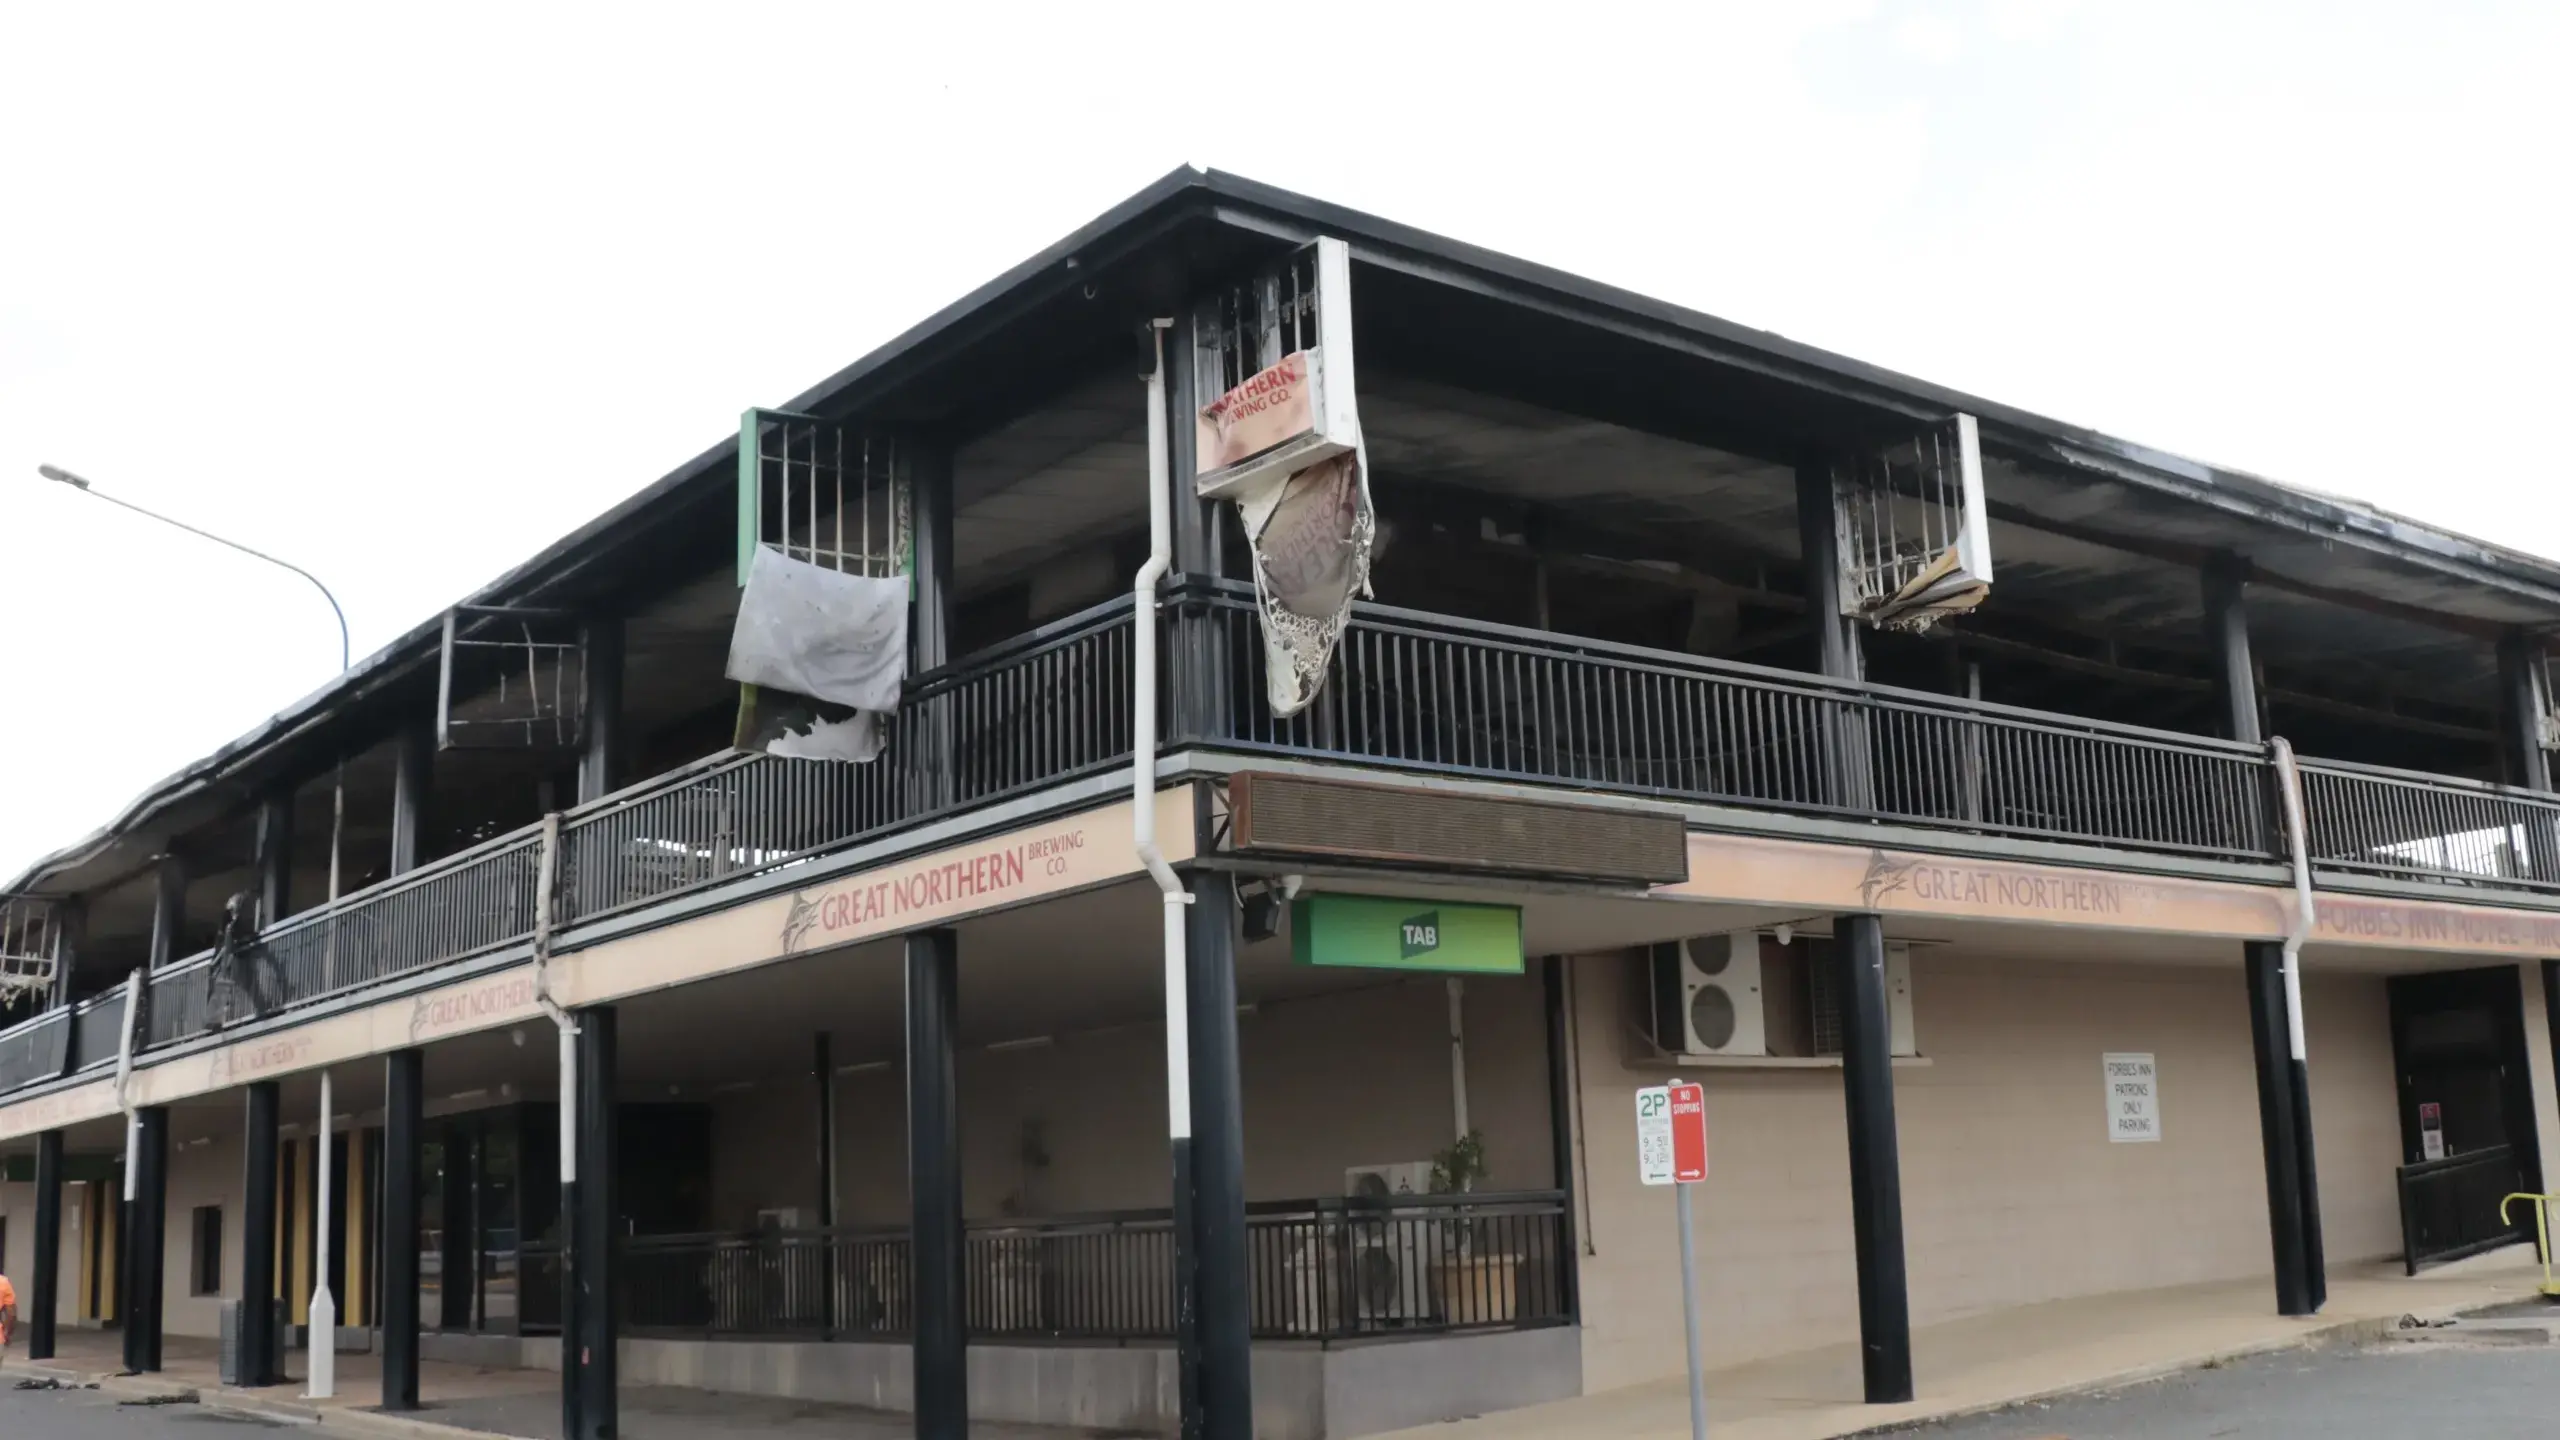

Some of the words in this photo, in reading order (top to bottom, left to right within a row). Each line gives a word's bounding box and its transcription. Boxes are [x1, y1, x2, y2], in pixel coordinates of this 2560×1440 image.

[1226, 397, 1267, 421] WING
[1269, 388, 1292, 405] CO.
[1028, 830, 1084, 860] BREWING
[1046, 857, 1068, 877] CO.
[822, 882, 889, 931] GREAT
[893, 846, 1024, 914] NORTHERN
[1913, 867, 1991, 903] GREAT
[1999, 876, 2120, 913] NORTHERN
[2316, 902, 2402, 938] FORBES
[2408, 908, 2448, 941] INN
[2453, 912, 2519, 945] HOTEL
[1403, 925, 1437, 946] TAB
[430, 993, 468, 1027] GREAT
[2108, 1062, 2137, 1077] FORBES
[2139, 1063, 2152, 1076] INN
[1680, 1090, 1690, 1100] NO
[2115, 1083, 2148, 1096] PATRONS
[1640, 1094, 1665, 1117] 2P
[1673, 1102, 1700, 1114] STOPPING
[2123, 1100, 2142, 1115] ONLY
[2118, 1118, 2151, 1133] PARKING
